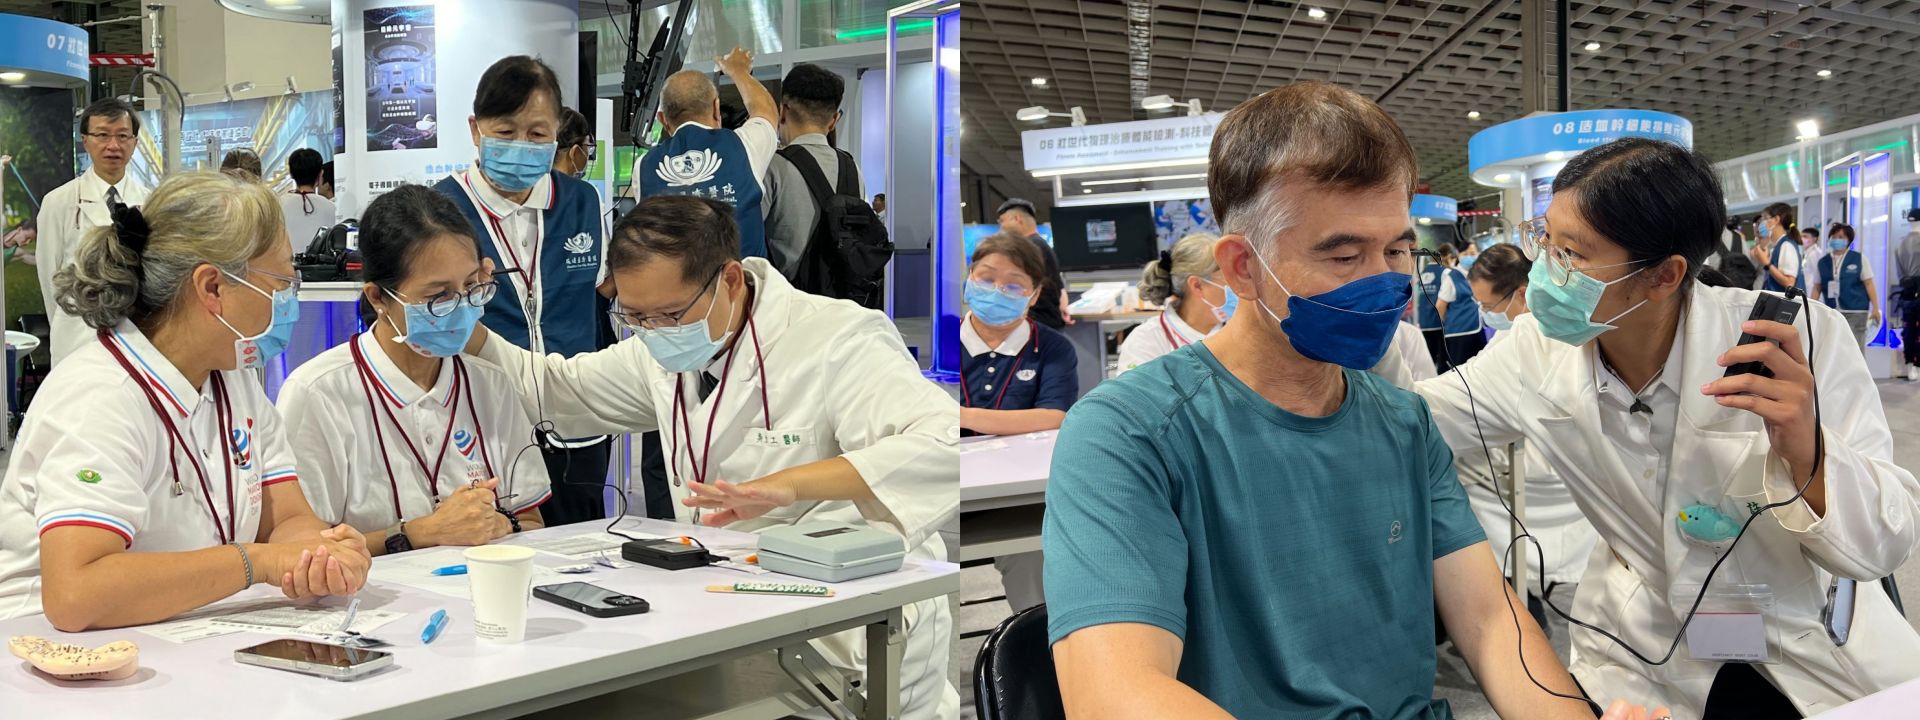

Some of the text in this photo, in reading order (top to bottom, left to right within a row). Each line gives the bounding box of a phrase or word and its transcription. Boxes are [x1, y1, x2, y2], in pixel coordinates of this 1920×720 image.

[47, 33, 65, 50] 07
[1552, 121, 1575, 135] 08
[1039, 139, 1054, 150] 06
